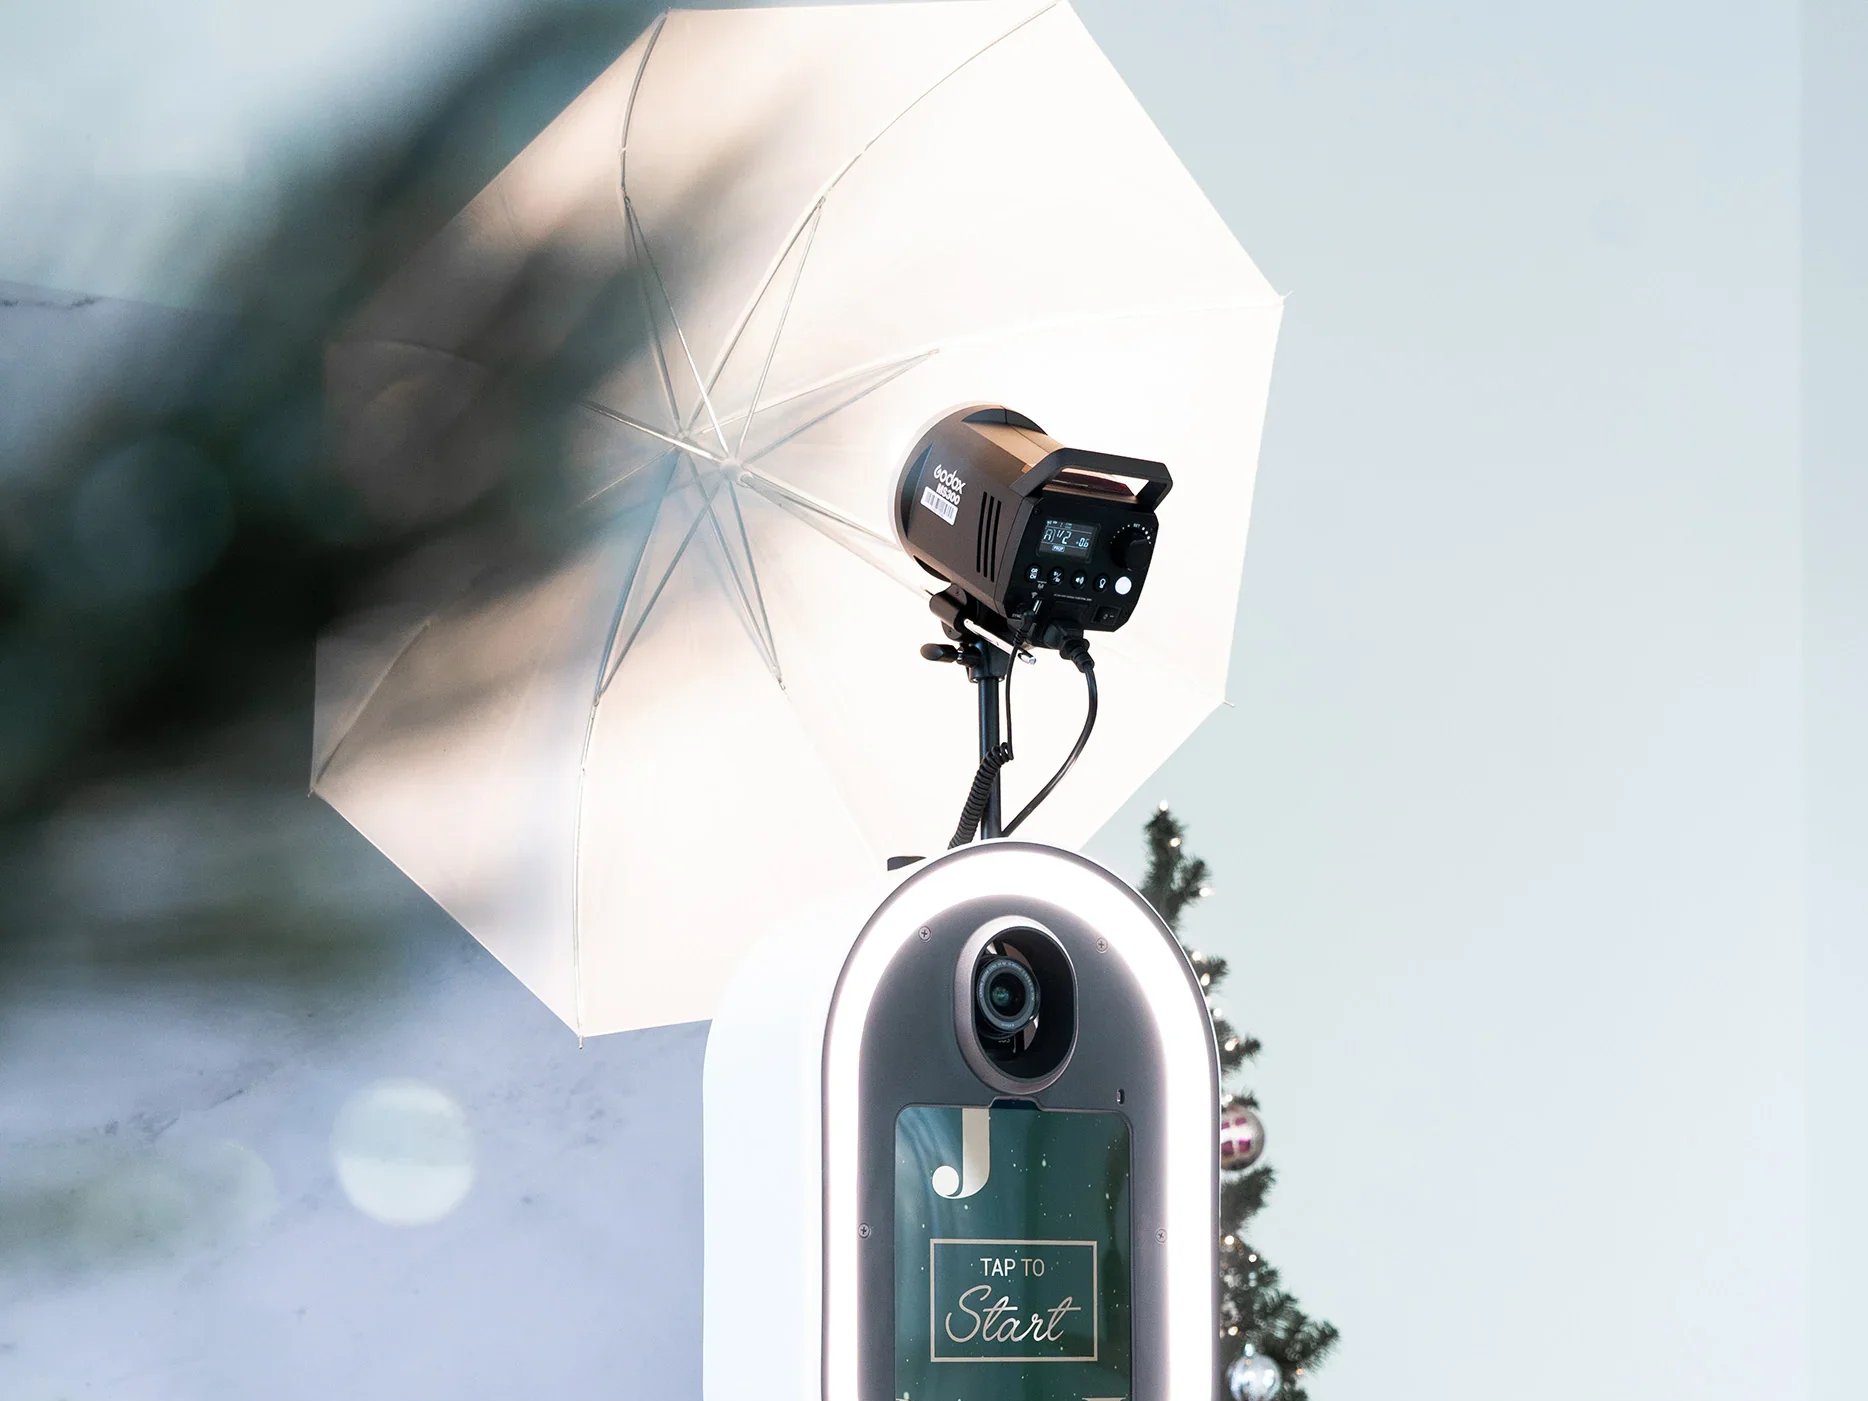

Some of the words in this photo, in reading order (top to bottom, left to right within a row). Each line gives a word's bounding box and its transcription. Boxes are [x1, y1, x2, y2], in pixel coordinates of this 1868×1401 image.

[933, 464, 966, 494] Godox
[936, 483, 961, 505] MS300
[980, 1257, 1016, 1277] TAP
[1021, 1258, 1045, 1277] TO
[945, 1284, 1082, 1343] Start
